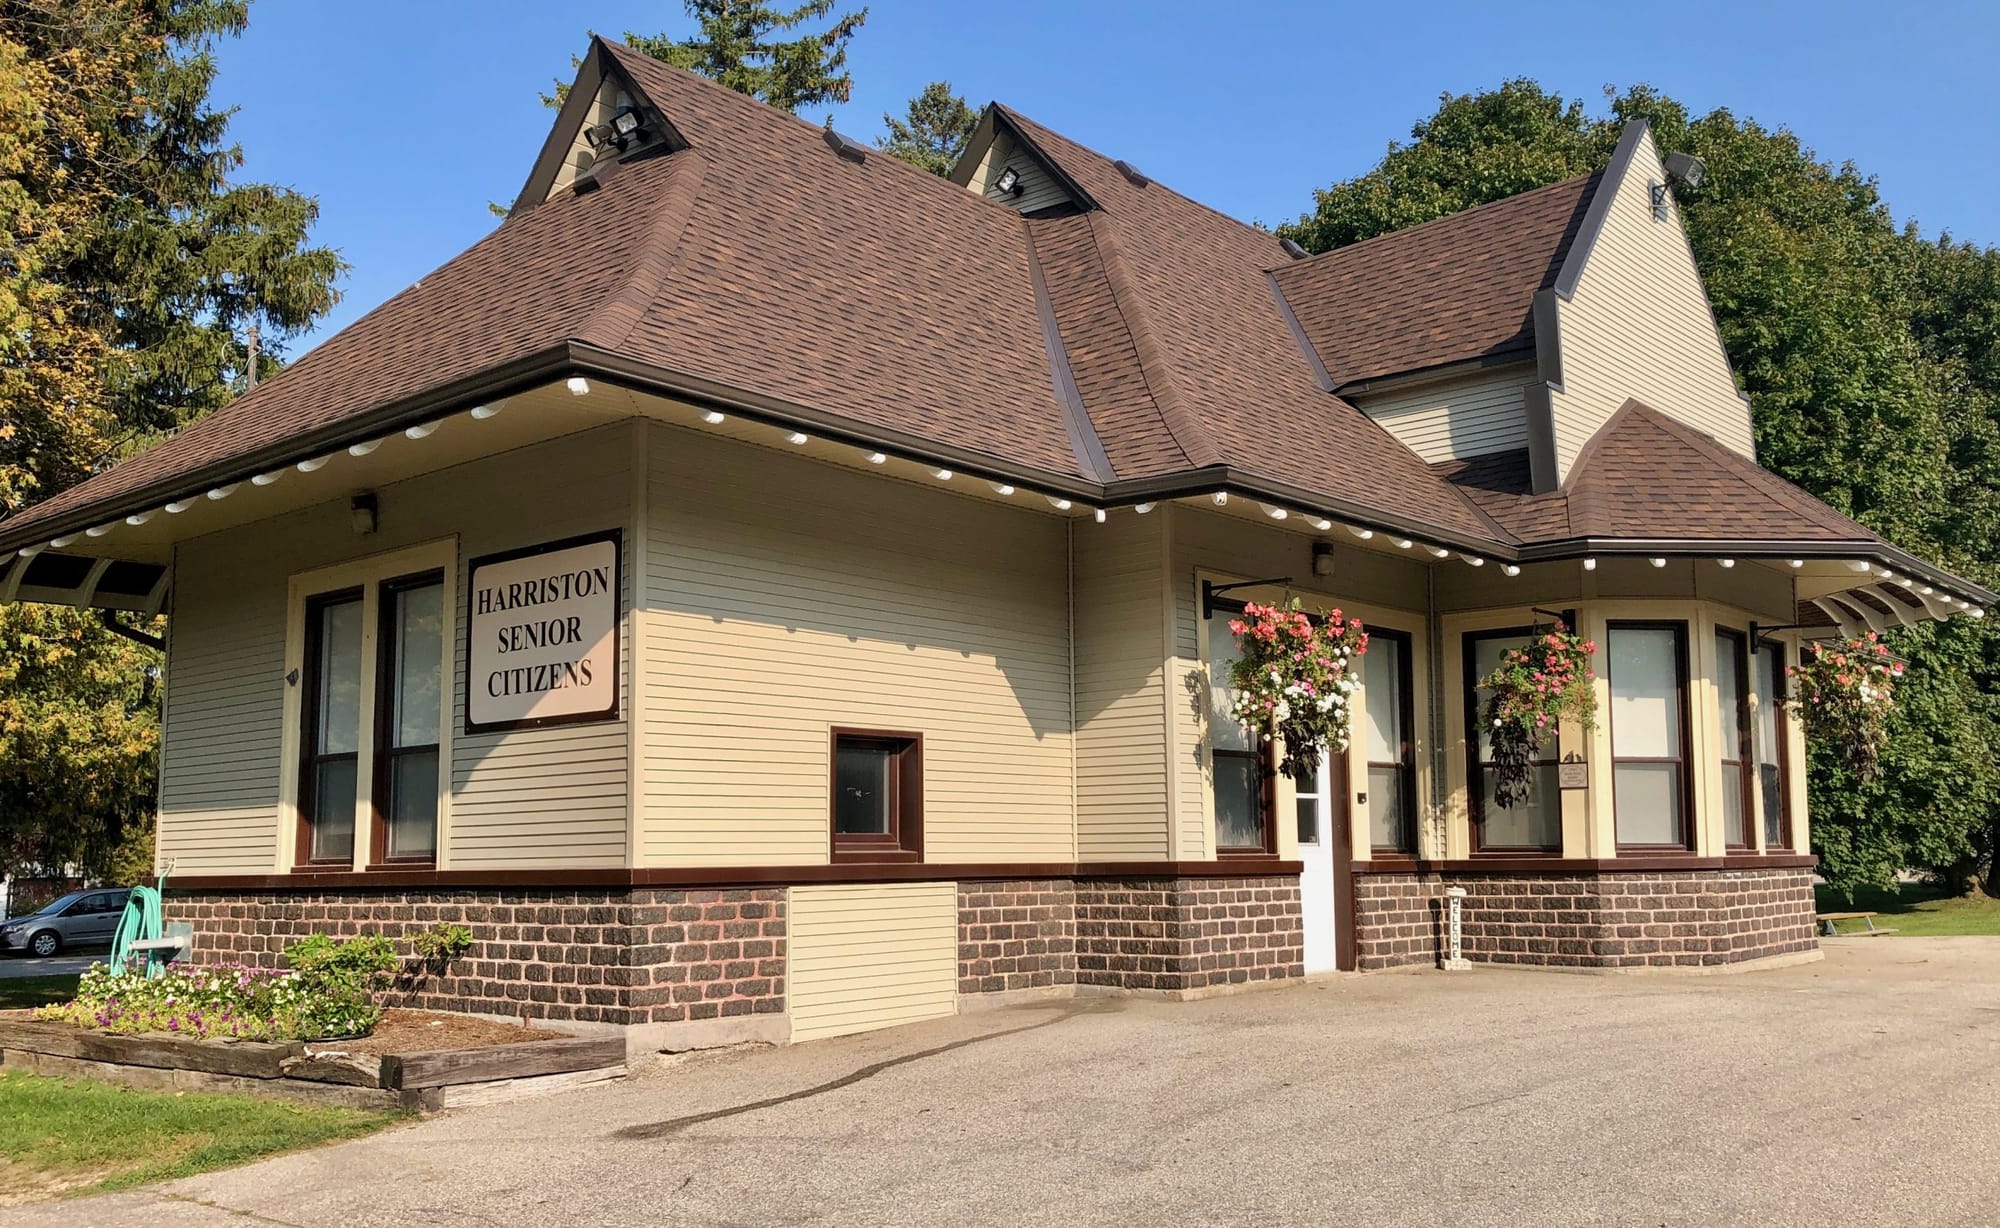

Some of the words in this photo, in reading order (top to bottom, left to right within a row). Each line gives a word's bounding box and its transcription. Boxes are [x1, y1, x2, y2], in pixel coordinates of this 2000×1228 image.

[478, 566, 610, 615] HARRISTON
[497, 616, 582, 654] SENIOR
[488, 659, 593, 698] CITIZENS
[1452, 897, 1460, 958] WELCOME
